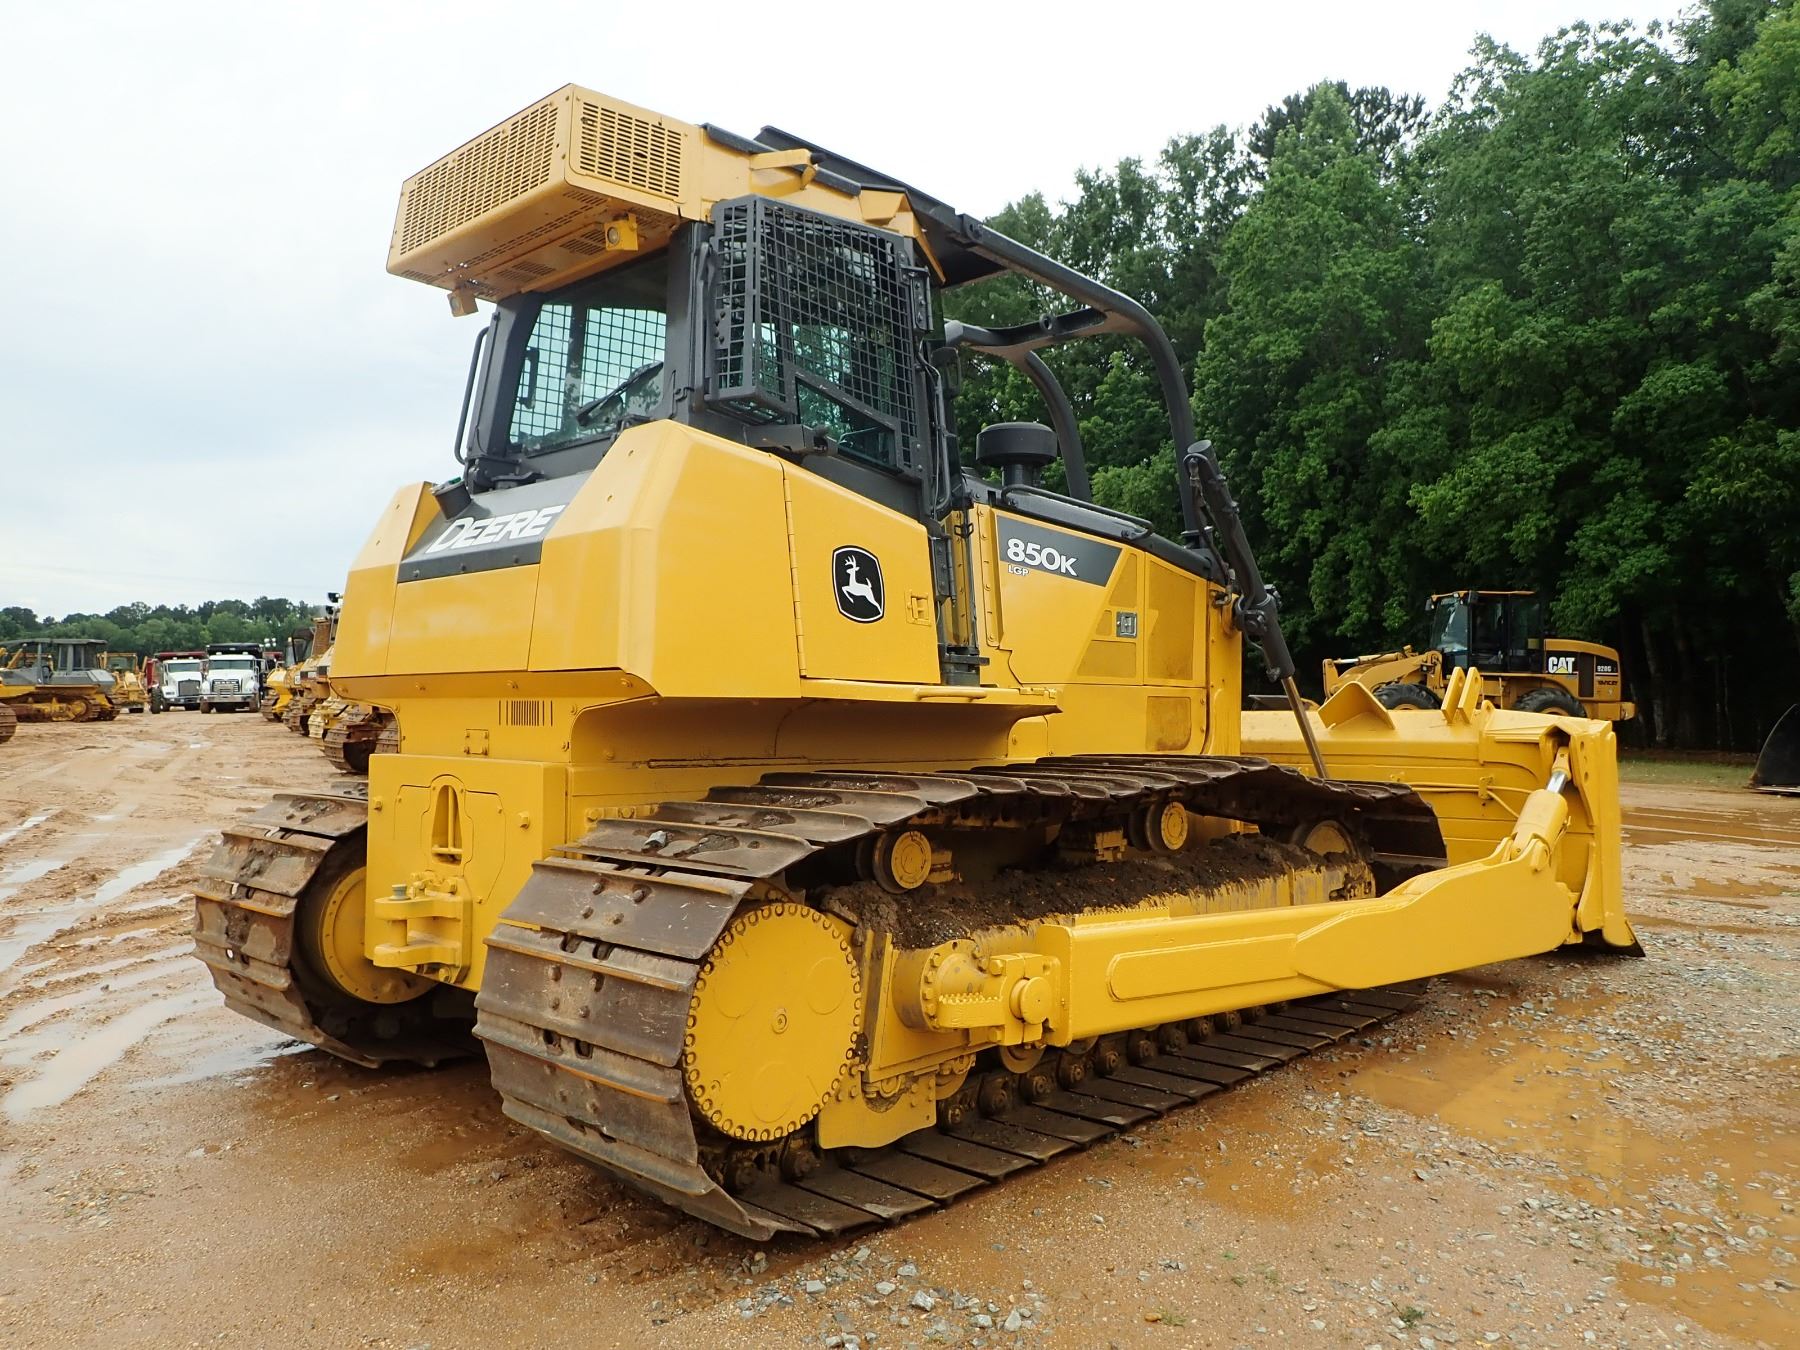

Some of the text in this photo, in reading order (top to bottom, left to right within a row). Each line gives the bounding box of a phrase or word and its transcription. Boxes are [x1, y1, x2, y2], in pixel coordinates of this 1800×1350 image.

[425, 504, 566, 553] DEERE
[1007, 538, 1078, 577] 850K
[1008, 564, 1029, 576] LGP
[1548, 656, 1575, 673] CAT
